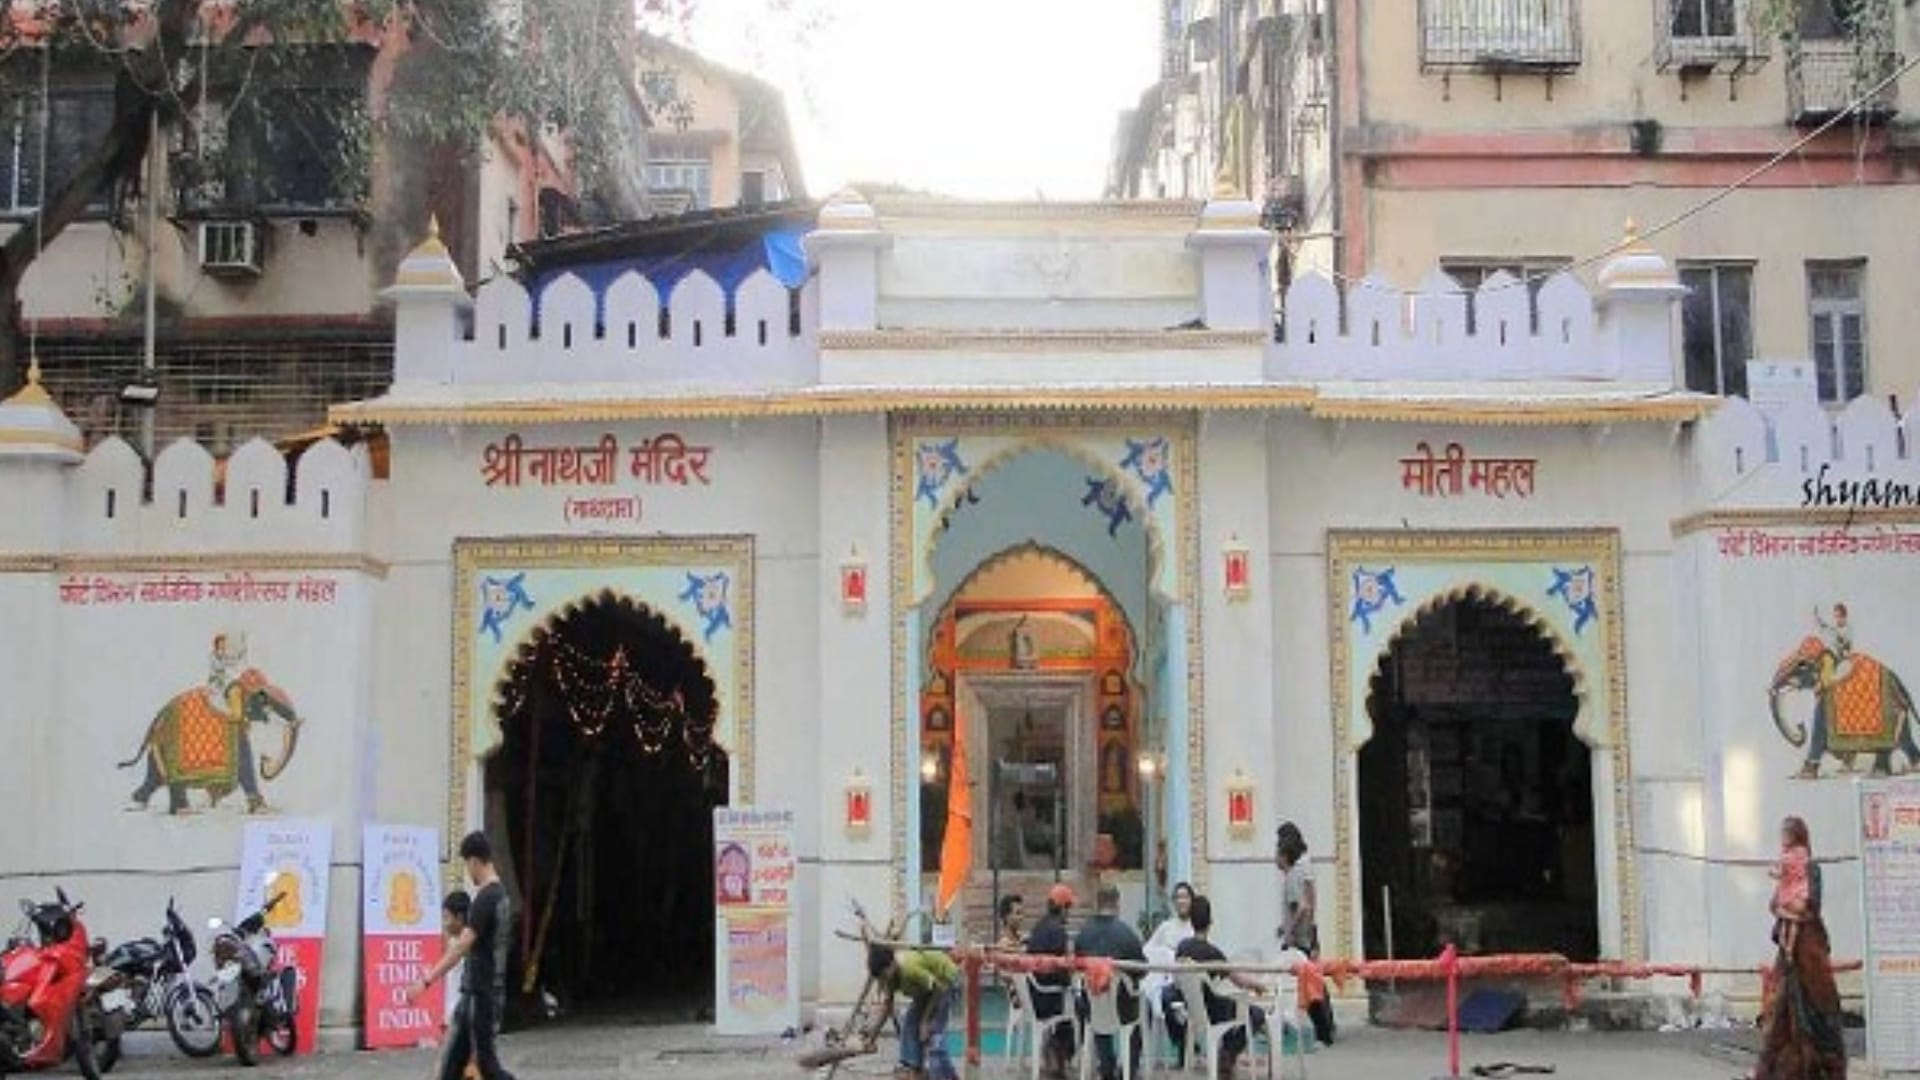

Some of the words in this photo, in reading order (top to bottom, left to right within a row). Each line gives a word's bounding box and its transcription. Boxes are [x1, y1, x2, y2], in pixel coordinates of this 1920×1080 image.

[481, 433, 617, 487] श्रीनाथजी
[629, 433, 713, 486] मंदिर
[1399, 442, 1465, 498] मोती
[1469, 458, 1536, 498] महल
[384, 940, 423, 961] THE
[378, 1008, 433, 1030] INDIA
